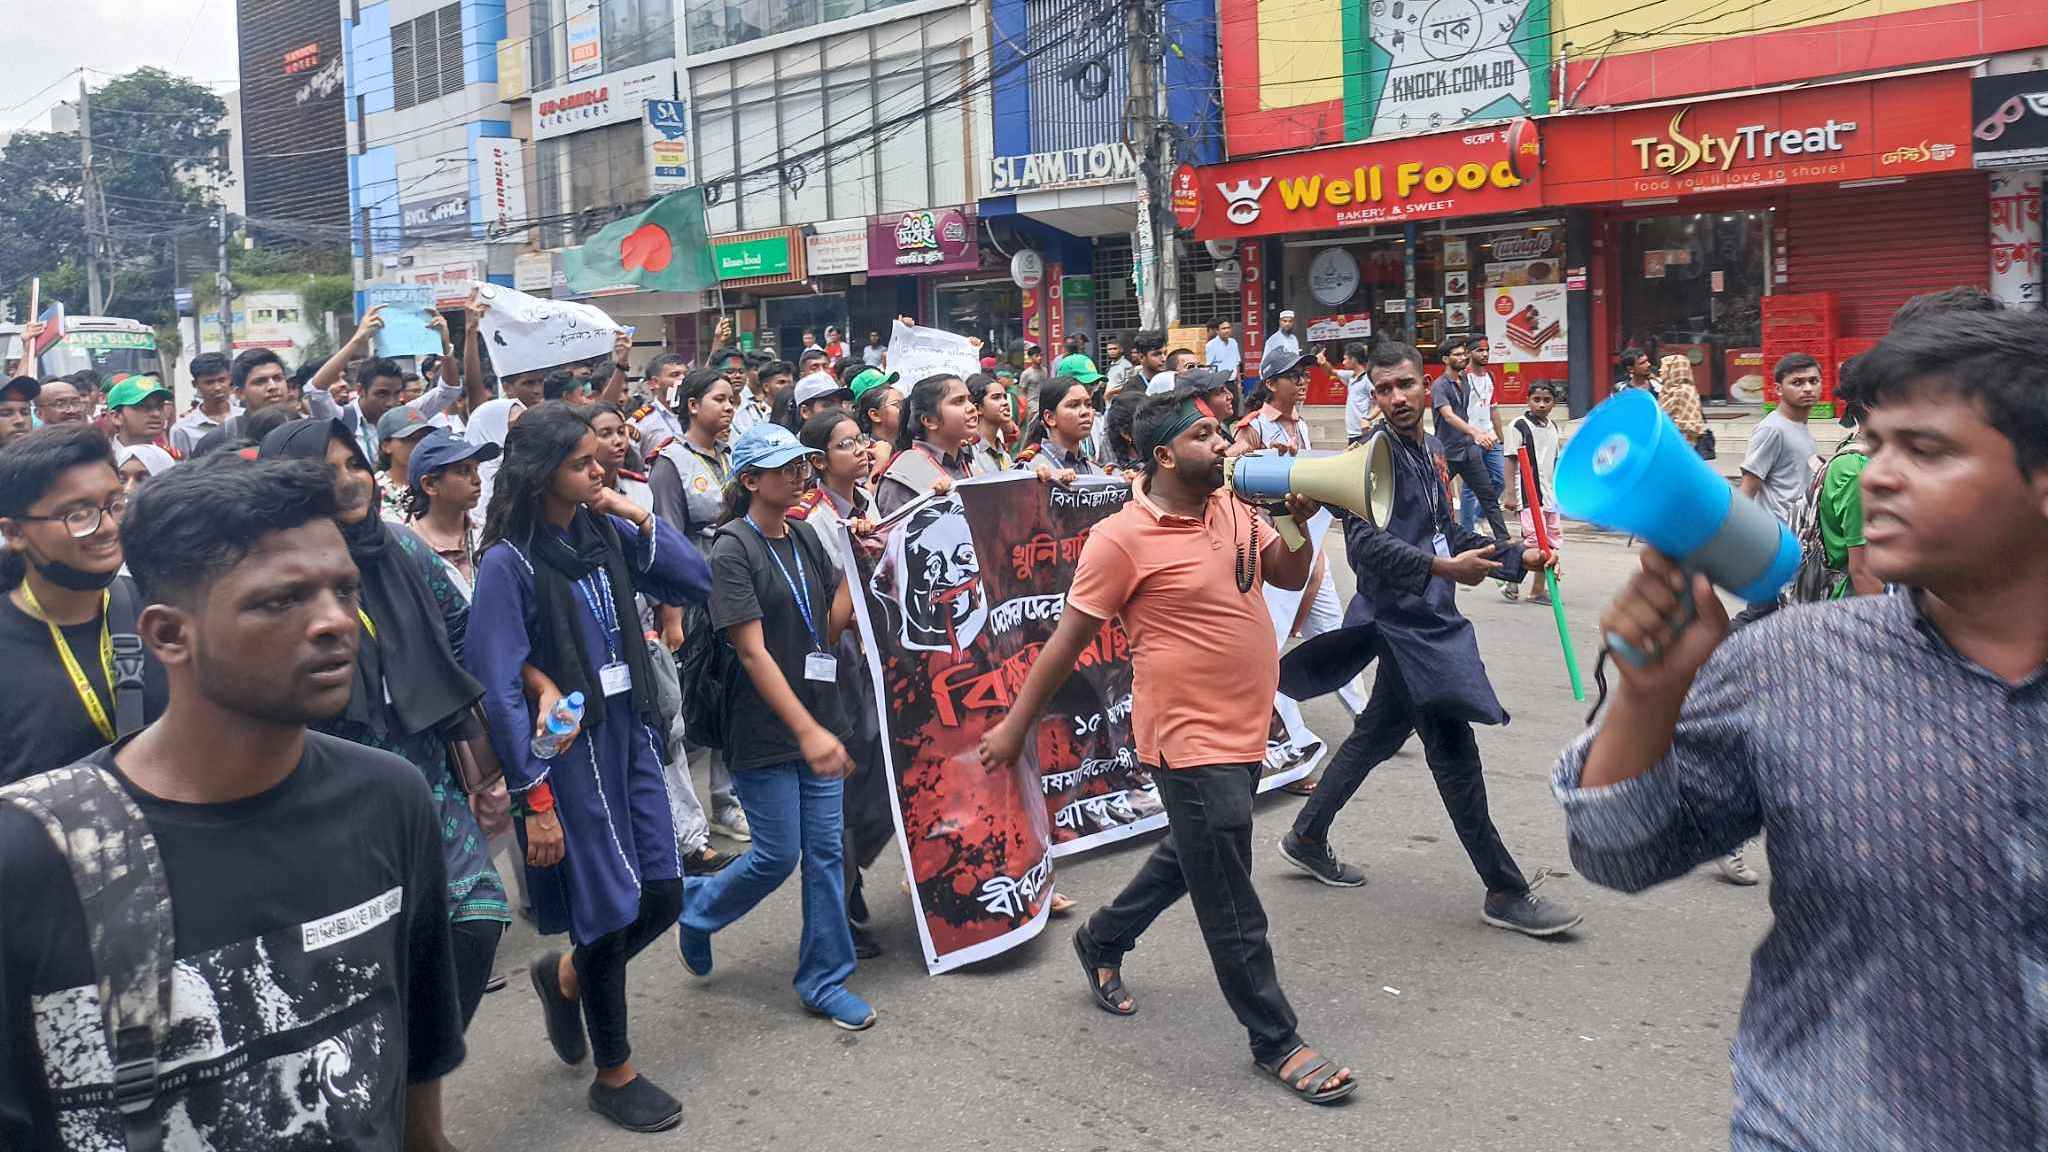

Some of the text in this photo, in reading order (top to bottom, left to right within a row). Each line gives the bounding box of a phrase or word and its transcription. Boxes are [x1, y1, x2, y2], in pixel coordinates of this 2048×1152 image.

[1429, 17, 1473, 45] নক
[1392, 59, 1515, 103] KNOCK.COM.BD
[1736, 119, 1843, 160] Treat
[1071, 142, 1137, 181] TOW
[1634, 180, 1671, 192] food
[1726, 171, 1761, 184] love
[1768, 169, 1785, 180] to
[1791, 162, 1846, 177] share!
[1278, 164, 1383, 211] Well
[1336, 207, 1386, 221] BAKERY
[1391, 205, 1402, 215] &
[1405, 199, 1455, 213] SWEET
[1012, 532, 1057, 580] খুনি
